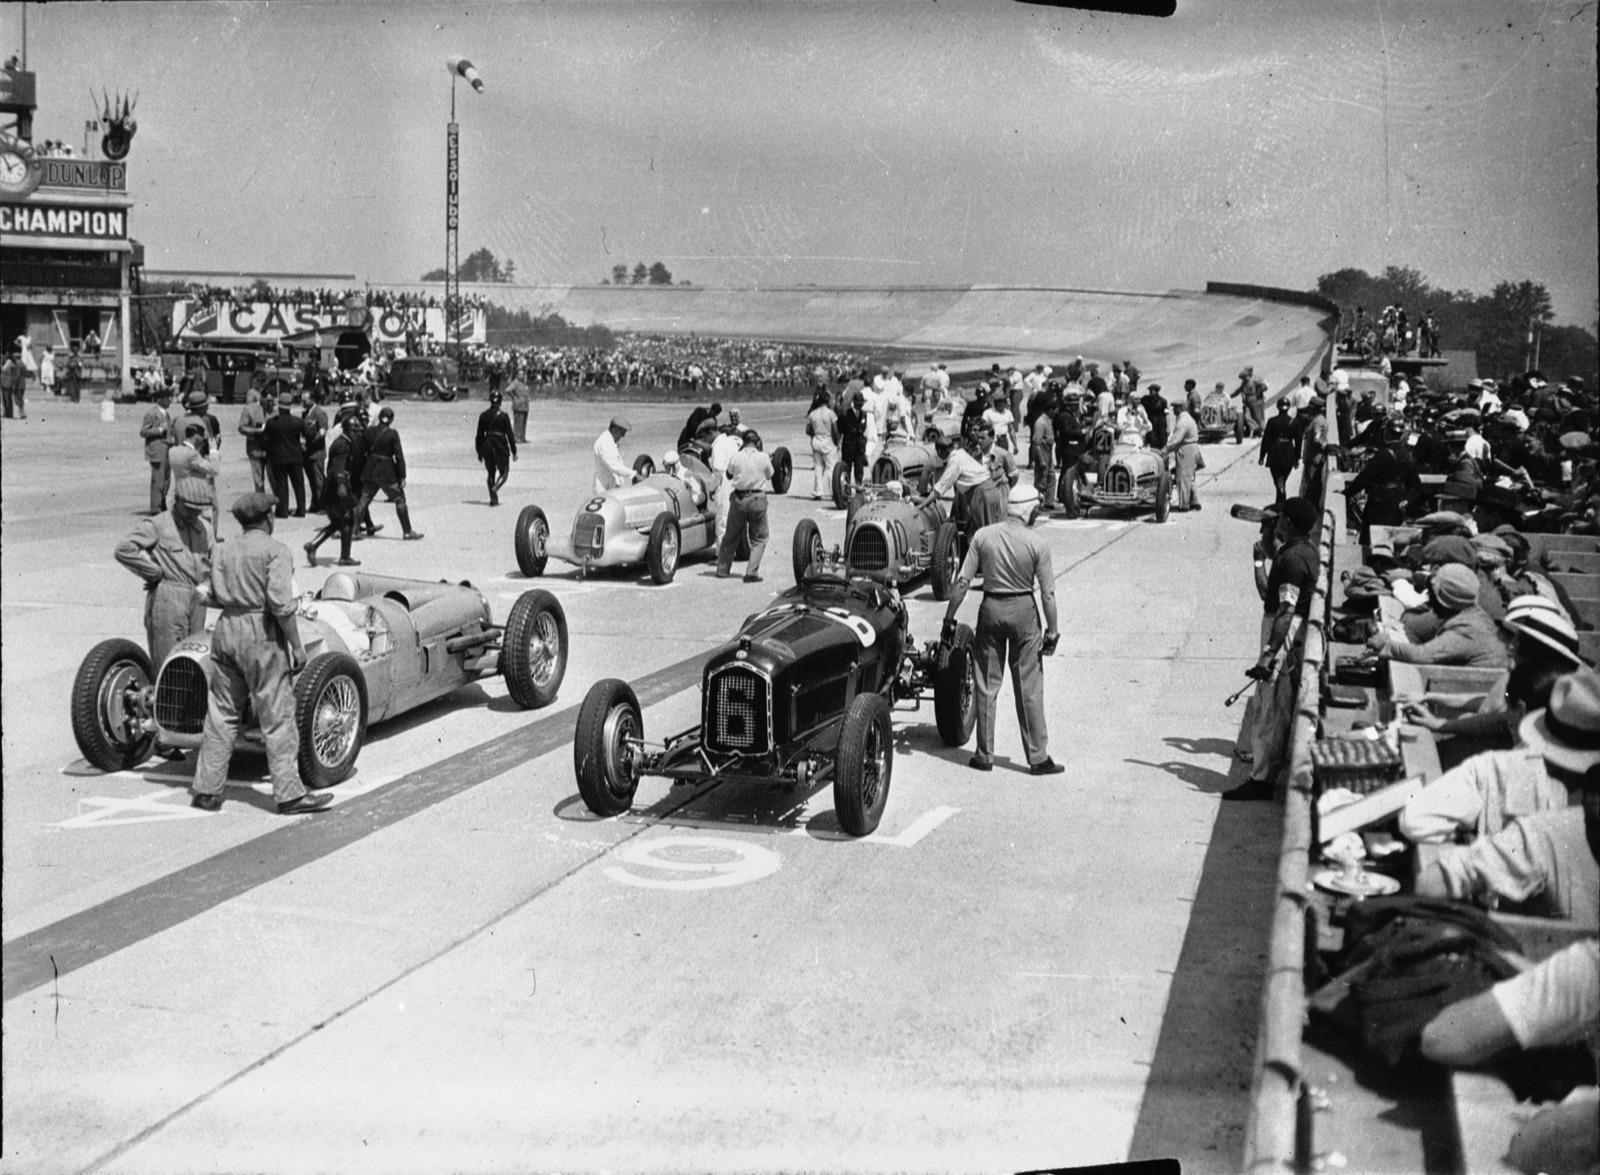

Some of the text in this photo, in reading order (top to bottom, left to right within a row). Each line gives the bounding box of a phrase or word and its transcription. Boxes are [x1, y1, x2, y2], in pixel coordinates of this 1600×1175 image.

[47, 162, 123, 186] DUNLOP
[0, 206, 123, 236] CHAMPION
[229, 304, 435, 339] CASTO
[1107, 470, 1129, 493] 16
[585, 496, 606, 512] 8
[886, 519, 909, 560] 10
[716, 675, 757, 748] 6
